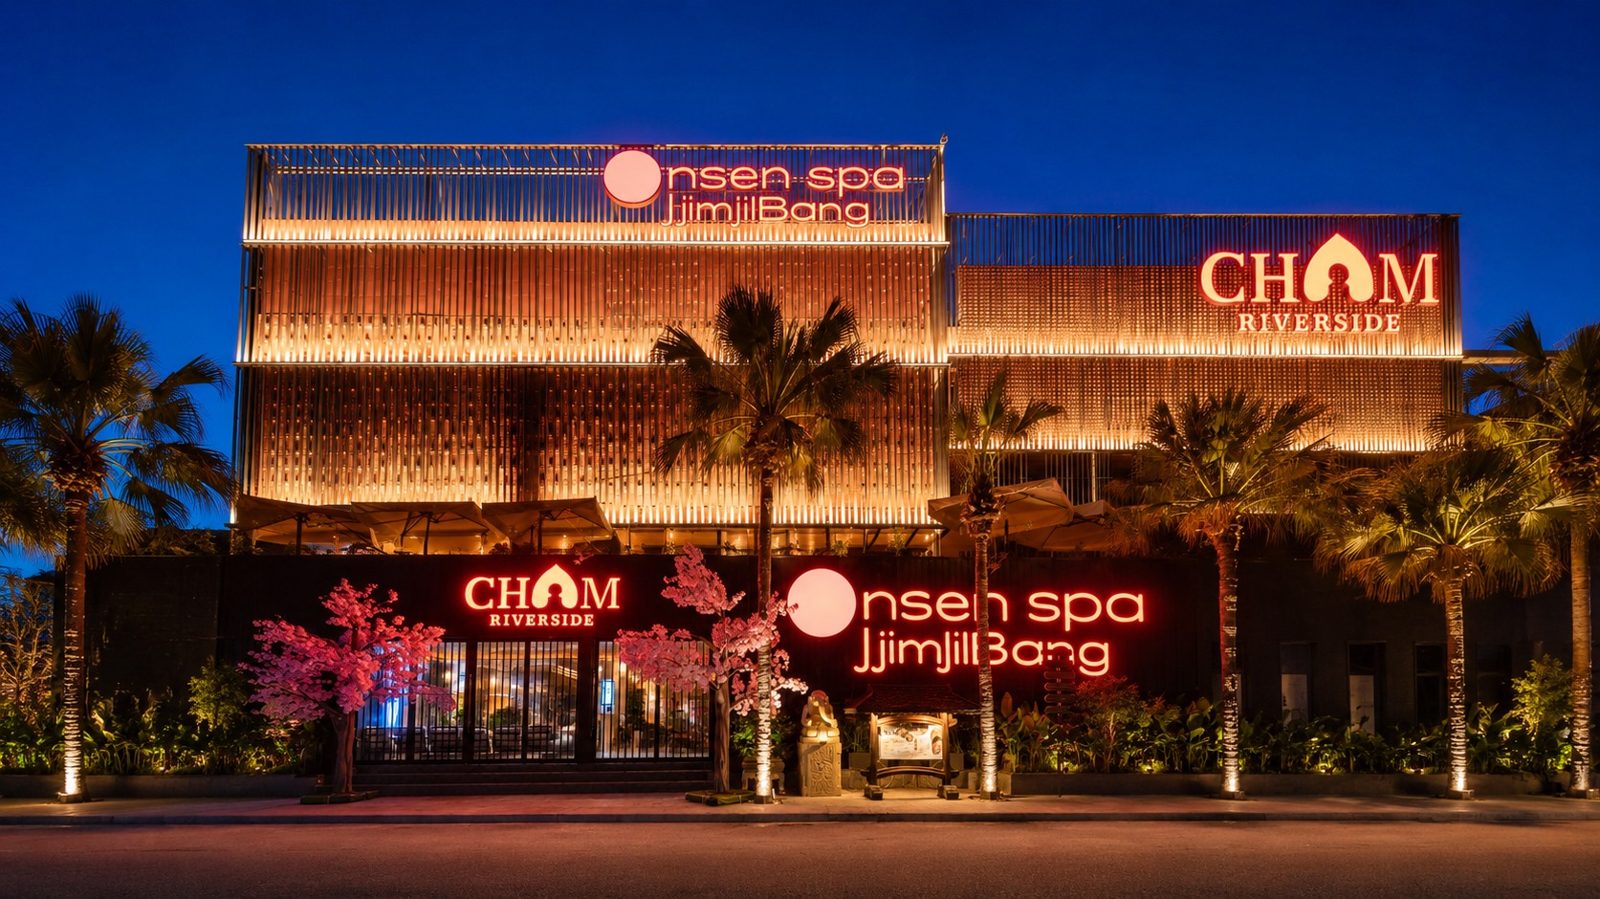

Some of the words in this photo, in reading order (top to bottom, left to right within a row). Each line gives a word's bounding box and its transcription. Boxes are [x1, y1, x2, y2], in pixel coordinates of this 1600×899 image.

[807, 166, 904, 197] spa
[1238, 313, 1401, 332] RIVERSIDE
[489, 613, 594, 627] RIVERSIDE
[1028, 591, 1145, 631] spa
